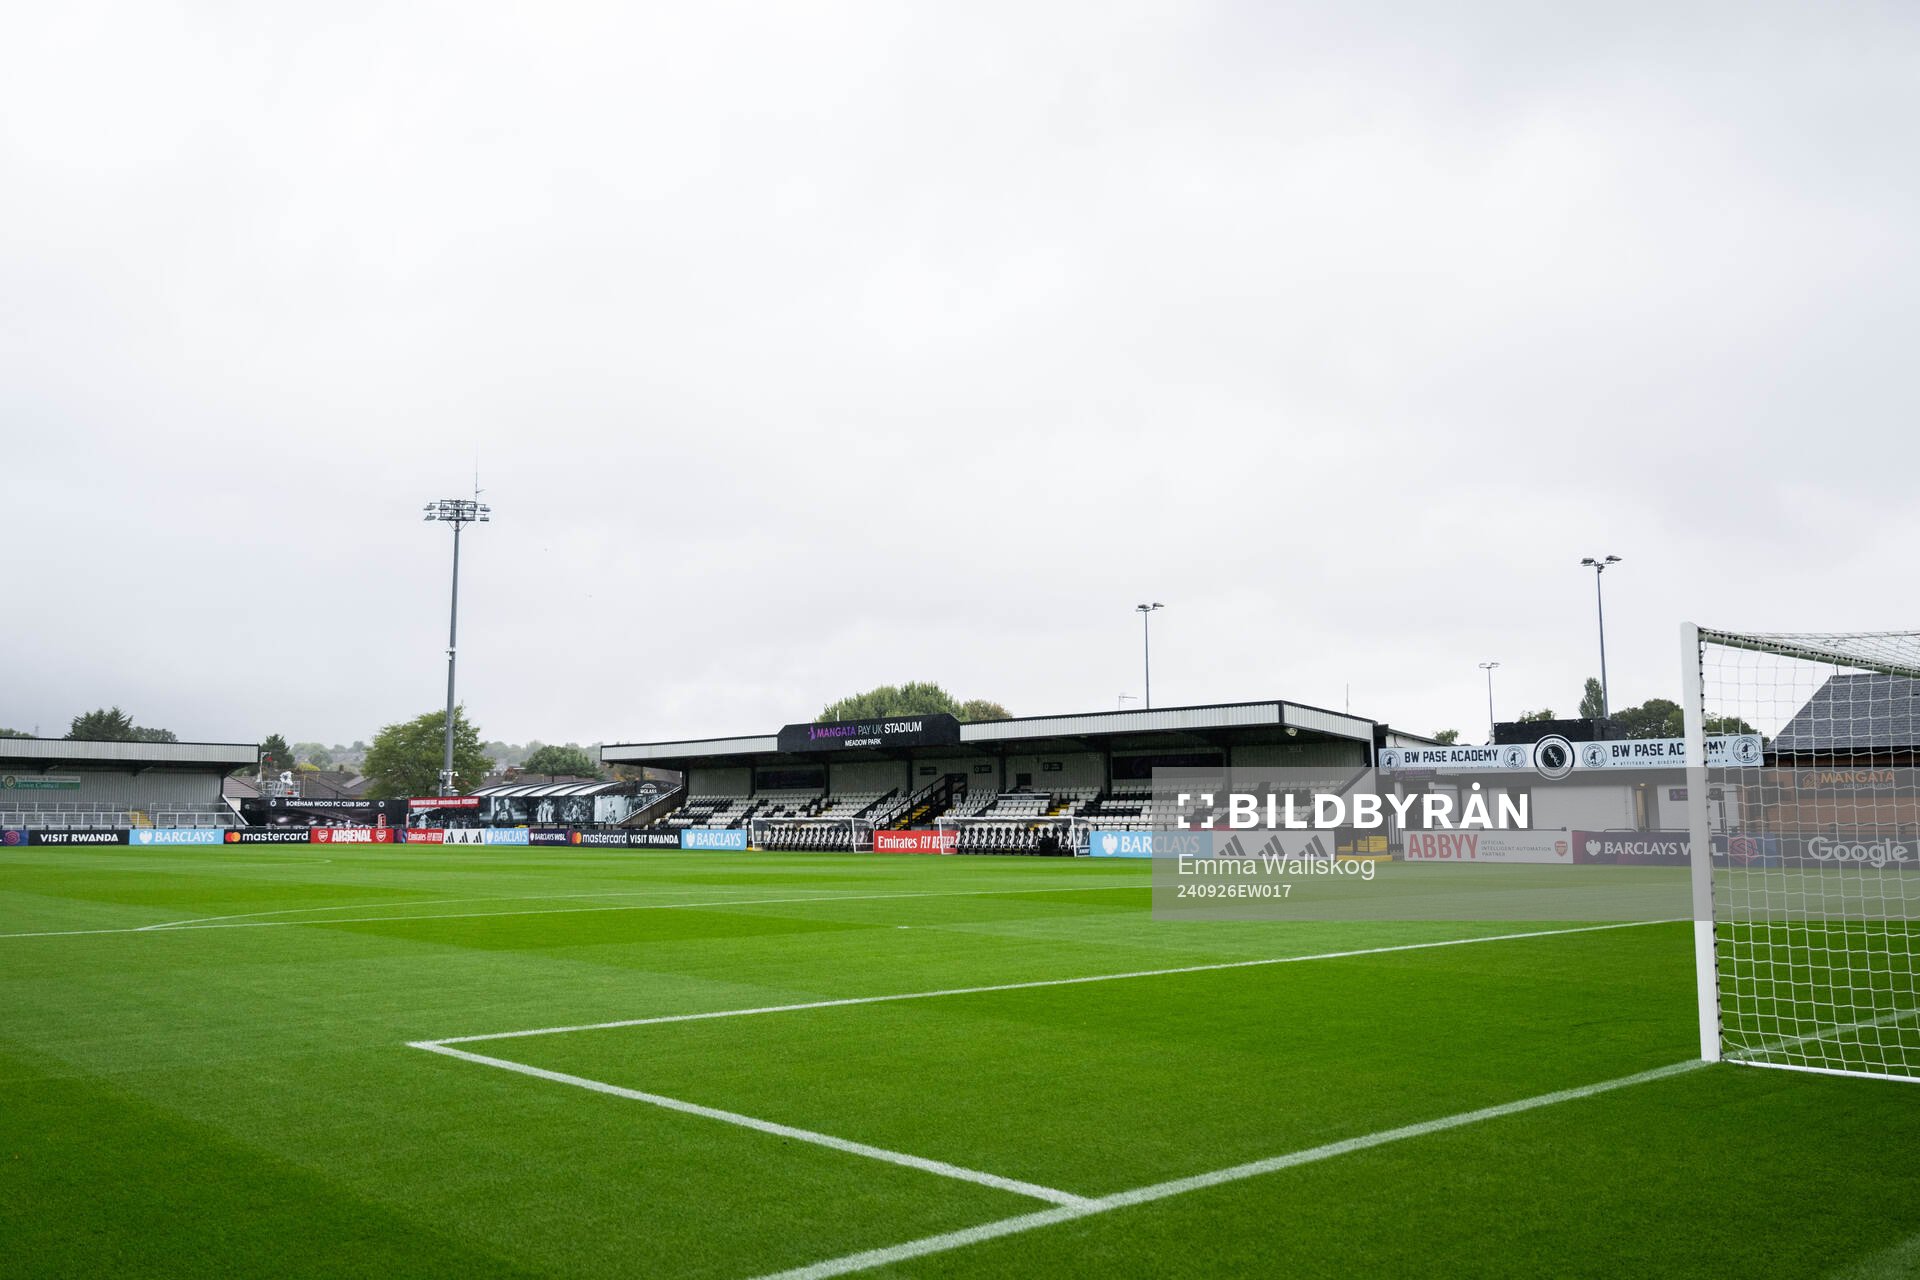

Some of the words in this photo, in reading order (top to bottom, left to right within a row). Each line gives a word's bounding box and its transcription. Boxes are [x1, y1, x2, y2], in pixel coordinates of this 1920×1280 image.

[817, 726, 857, 738] MANGATA
[858, 725, 872, 735] PAY
[873, 724, 884, 735] UK
[884, 721, 922, 734] STADIUM
[845, 739, 867, 747] MEADOW
[1404, 751, 1420, 763] BW
[1423, 750, 1448, 763] PASE
[1450, 749, 1498, 762] ACADEMY
[1612, 745, 1630, 758] BW
[1634, 743, 1664, 757] PASE
[1821, 771, 1896, 784] MANGATA
[40, 833, 69, 843] VISIT
[71, 833, 119, 843] RWANDA
[155, 831, 215, 843] BARCLAYS
[242, 831, 309, 842] mastercard
[331, 830, 373, 842] ARSENAL
[494, 829, 528, 842] BARCLAYS
[582, 832, 627, 844] mastercard
[629, 834, 647, 844] VISIT
[649, 834, 679, 844] RWANDA
[696, 832, 742, 847] BARCLAYS
[878, 835, 918, 849] Emirates
[1121, 835, 1200, 854] BARCLAYS
[1408, 834, 1478, 859] ABBYY
[1604, 841, 1678, 856] BARCLAYS
[1808, 836, 1909, 868] Google
